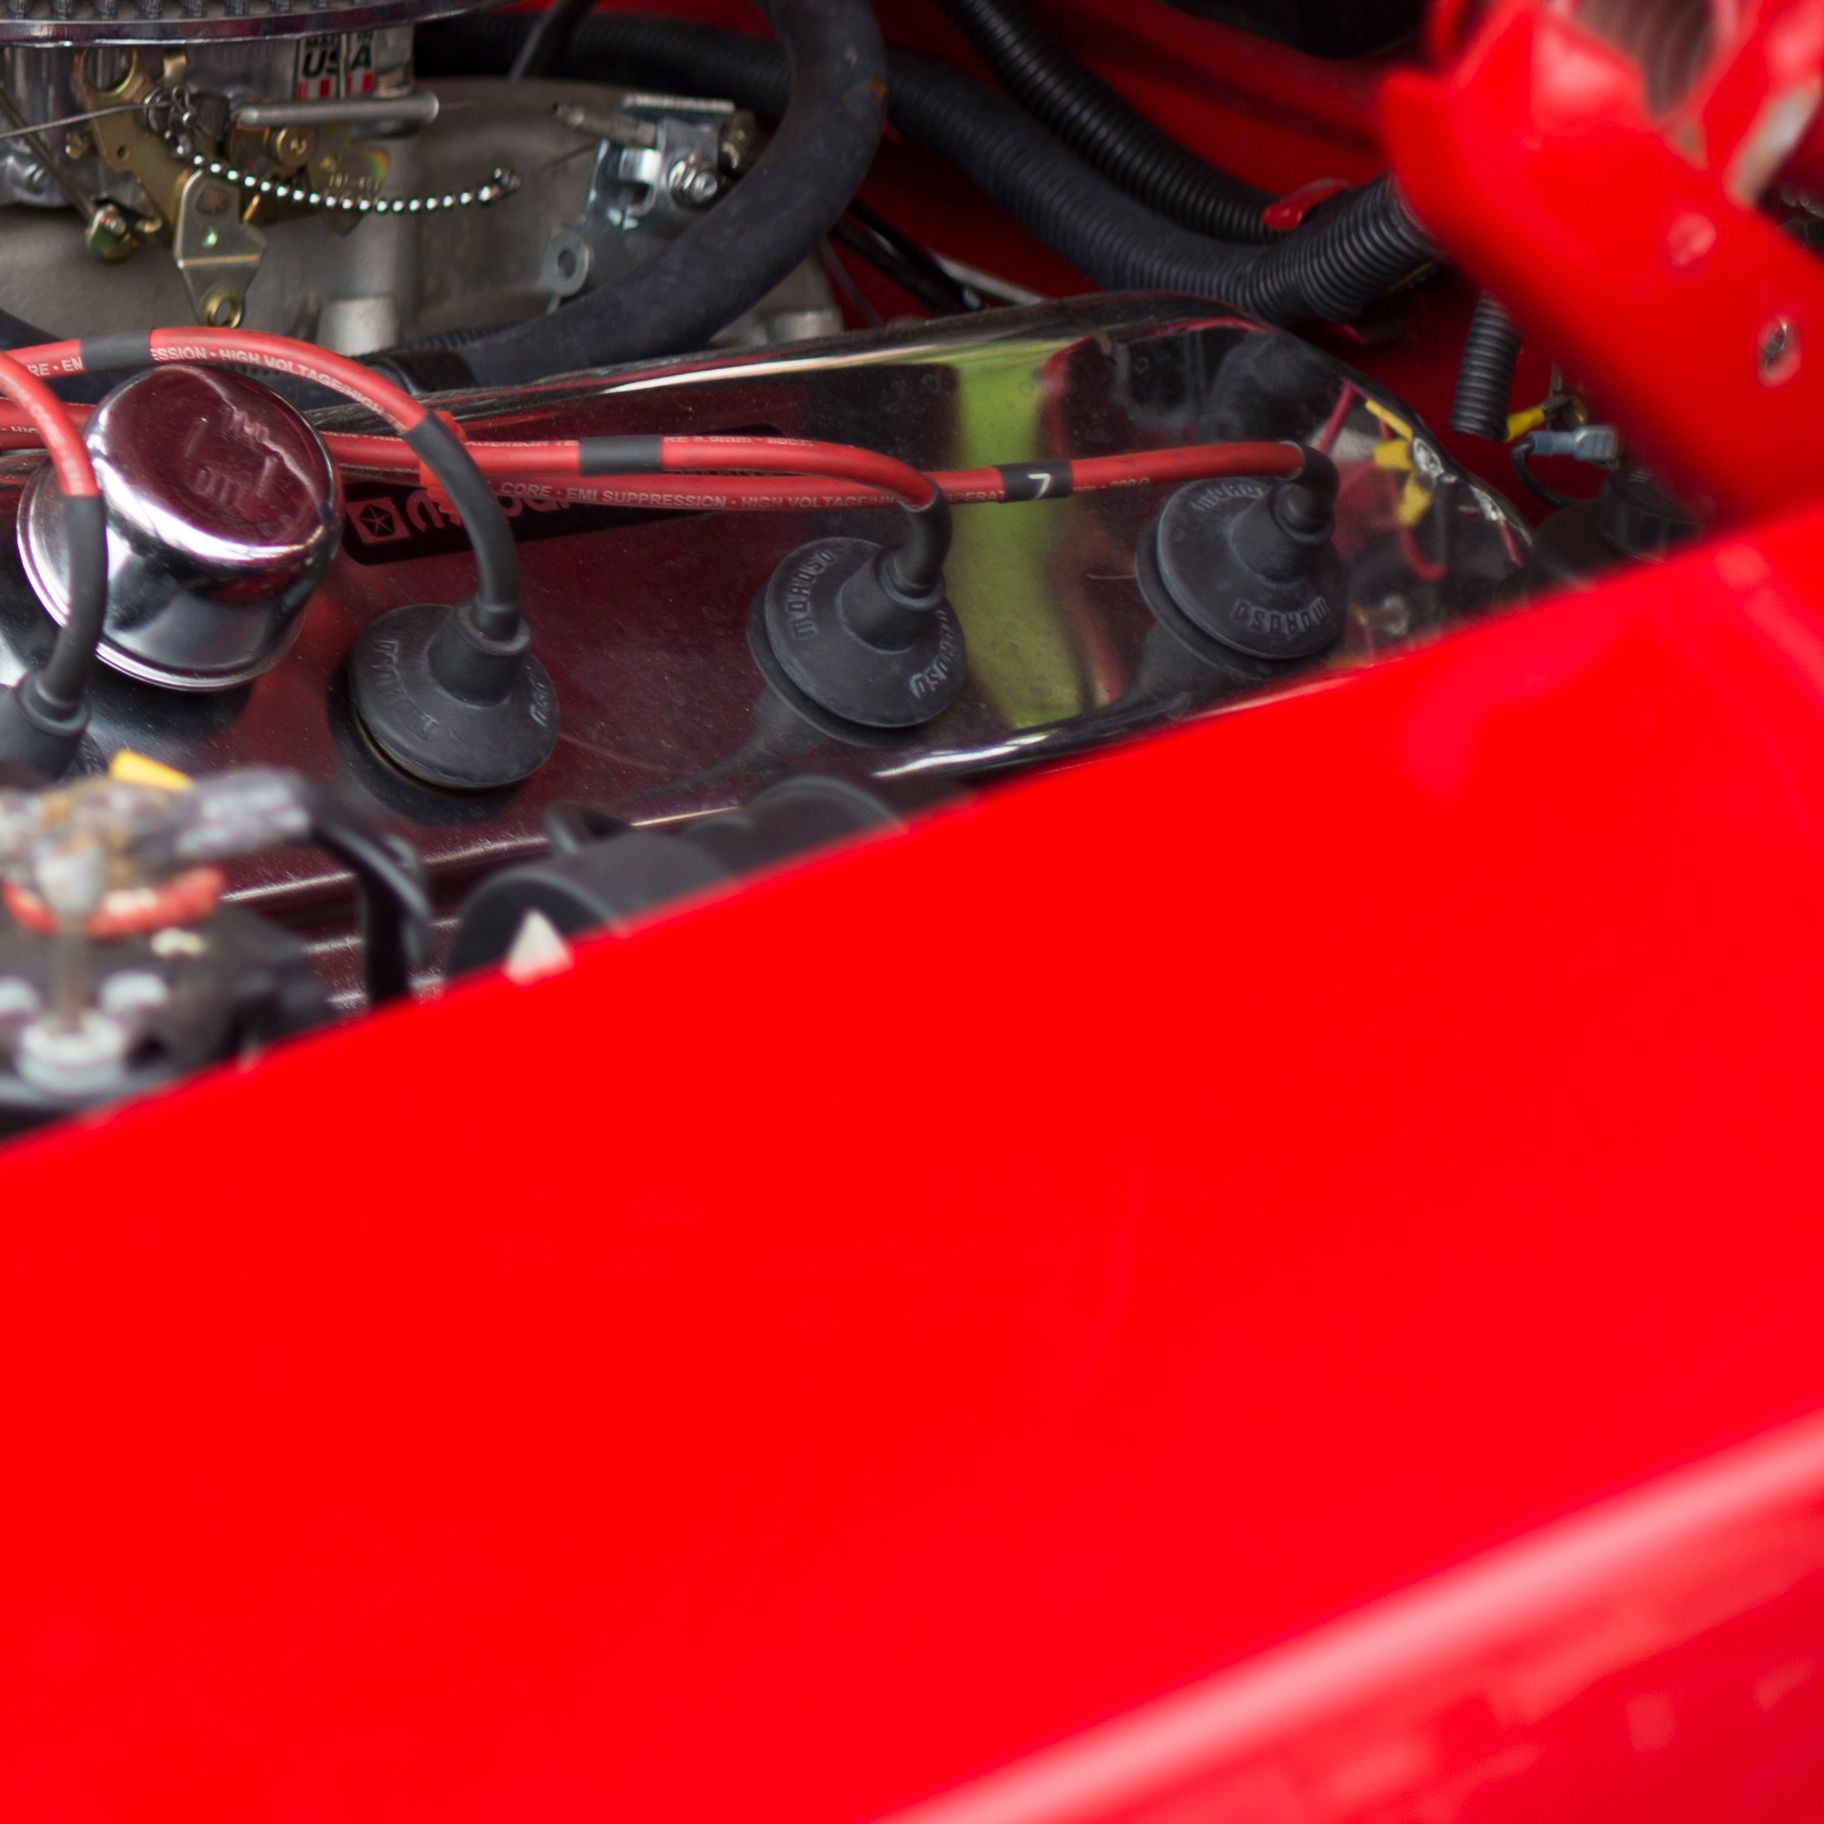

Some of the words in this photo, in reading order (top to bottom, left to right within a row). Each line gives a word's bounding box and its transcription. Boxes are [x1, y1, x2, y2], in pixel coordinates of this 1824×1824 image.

[220, 349, 260, 366] HIGH
[501, 481, 551, 498] CORE
[566, 487, 598, 501] EMI
[602, 490, 727, 509] SUPPRESSION
[1027, 472, 1051, 499] 7
